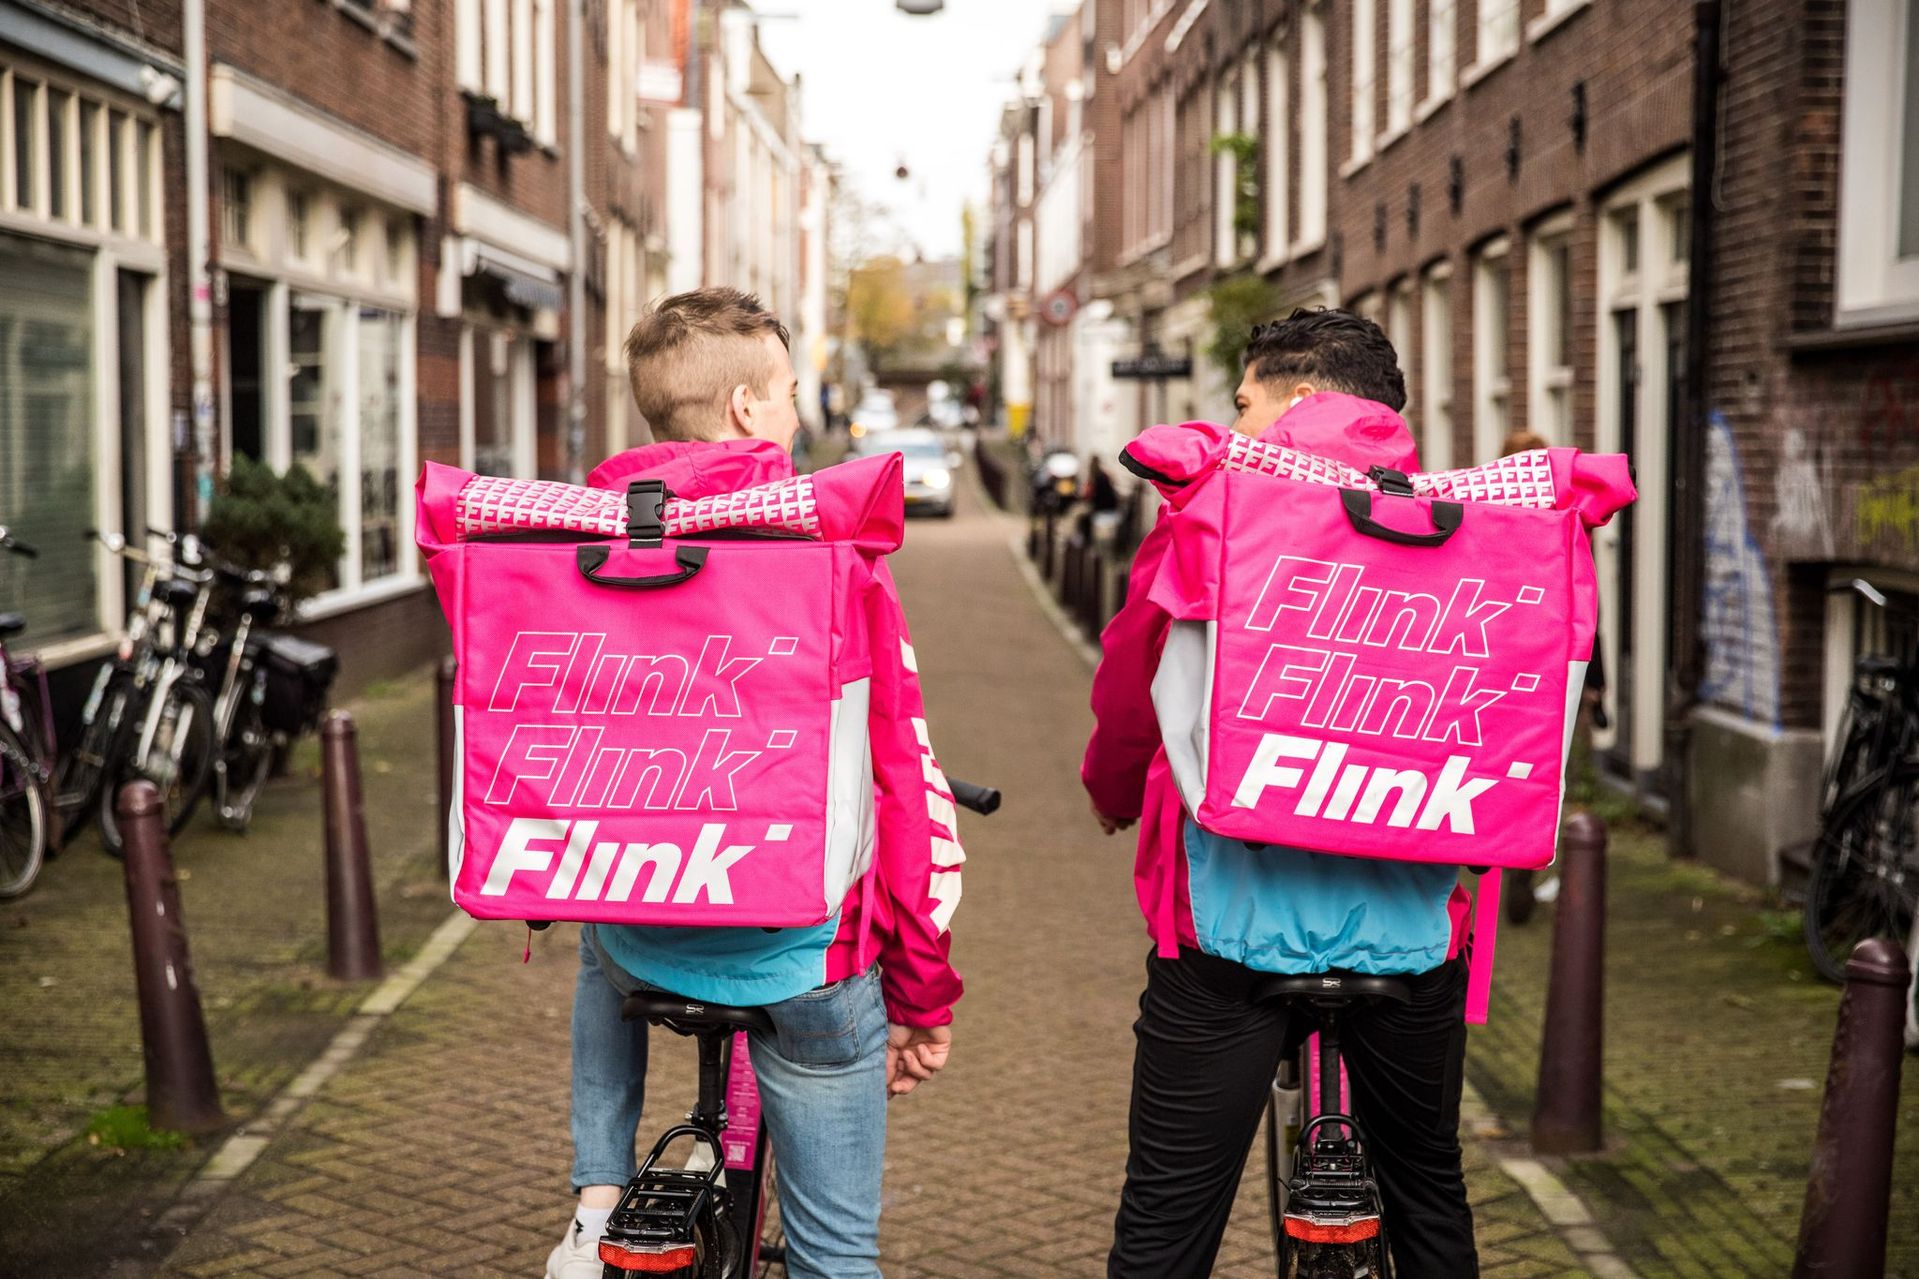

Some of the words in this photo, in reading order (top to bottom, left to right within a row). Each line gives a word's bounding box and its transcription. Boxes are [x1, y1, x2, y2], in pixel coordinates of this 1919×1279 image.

[1243, 554, 1546, 659] Flink
[487, 631, 800, 718] Flink
[1236, 643, 1541, 747] Flink
[484, 724, 799, 811] Flink
[1230, 732, 1534, 835] Flink
[479, 817, 794, 905] Flink
